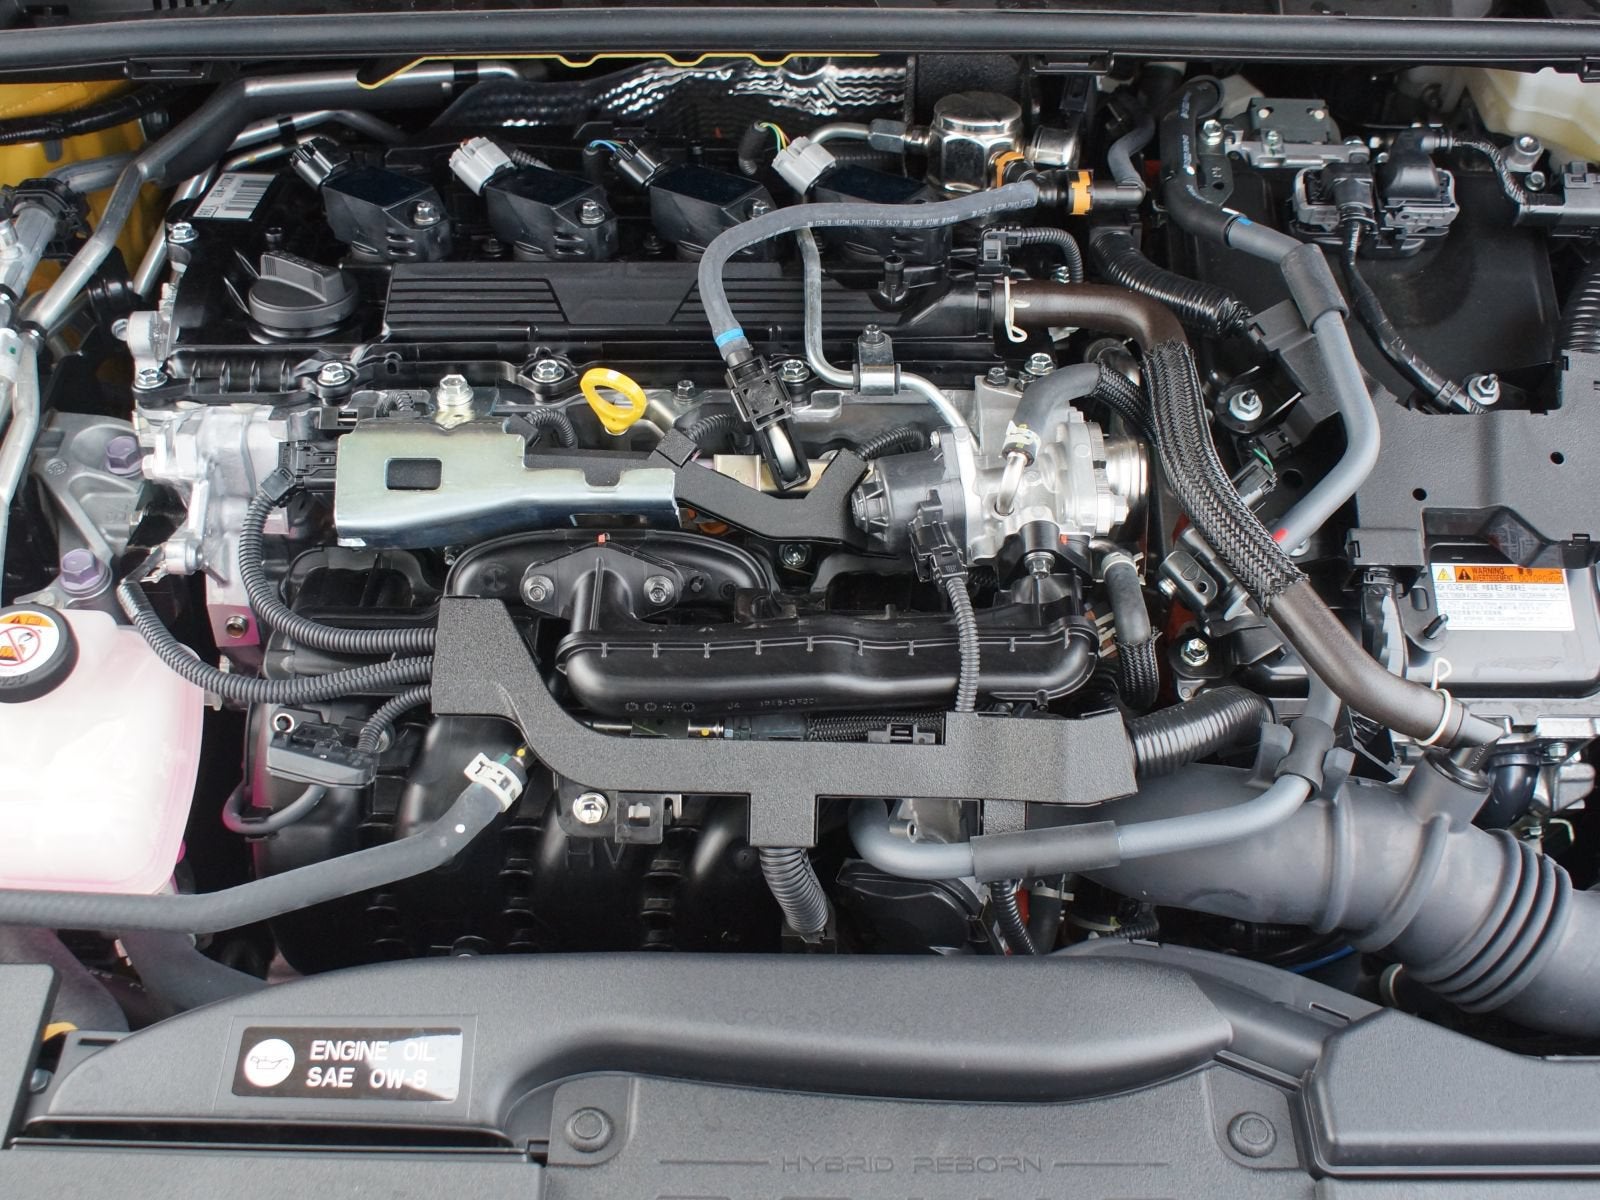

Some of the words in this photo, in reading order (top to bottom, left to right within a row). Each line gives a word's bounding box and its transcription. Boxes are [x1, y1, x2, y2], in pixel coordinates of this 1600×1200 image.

[1471, 567, 1505, 576] WARNING
[309, 1040, 389, 1061] ENGINE
[403, 1041, 436, 1061] OIL
[306, 1066, 355, 1088] SAE
[781, 1155, 895, 1174] HYBRID
[913, 1155, 1042, 1174] REBORN
